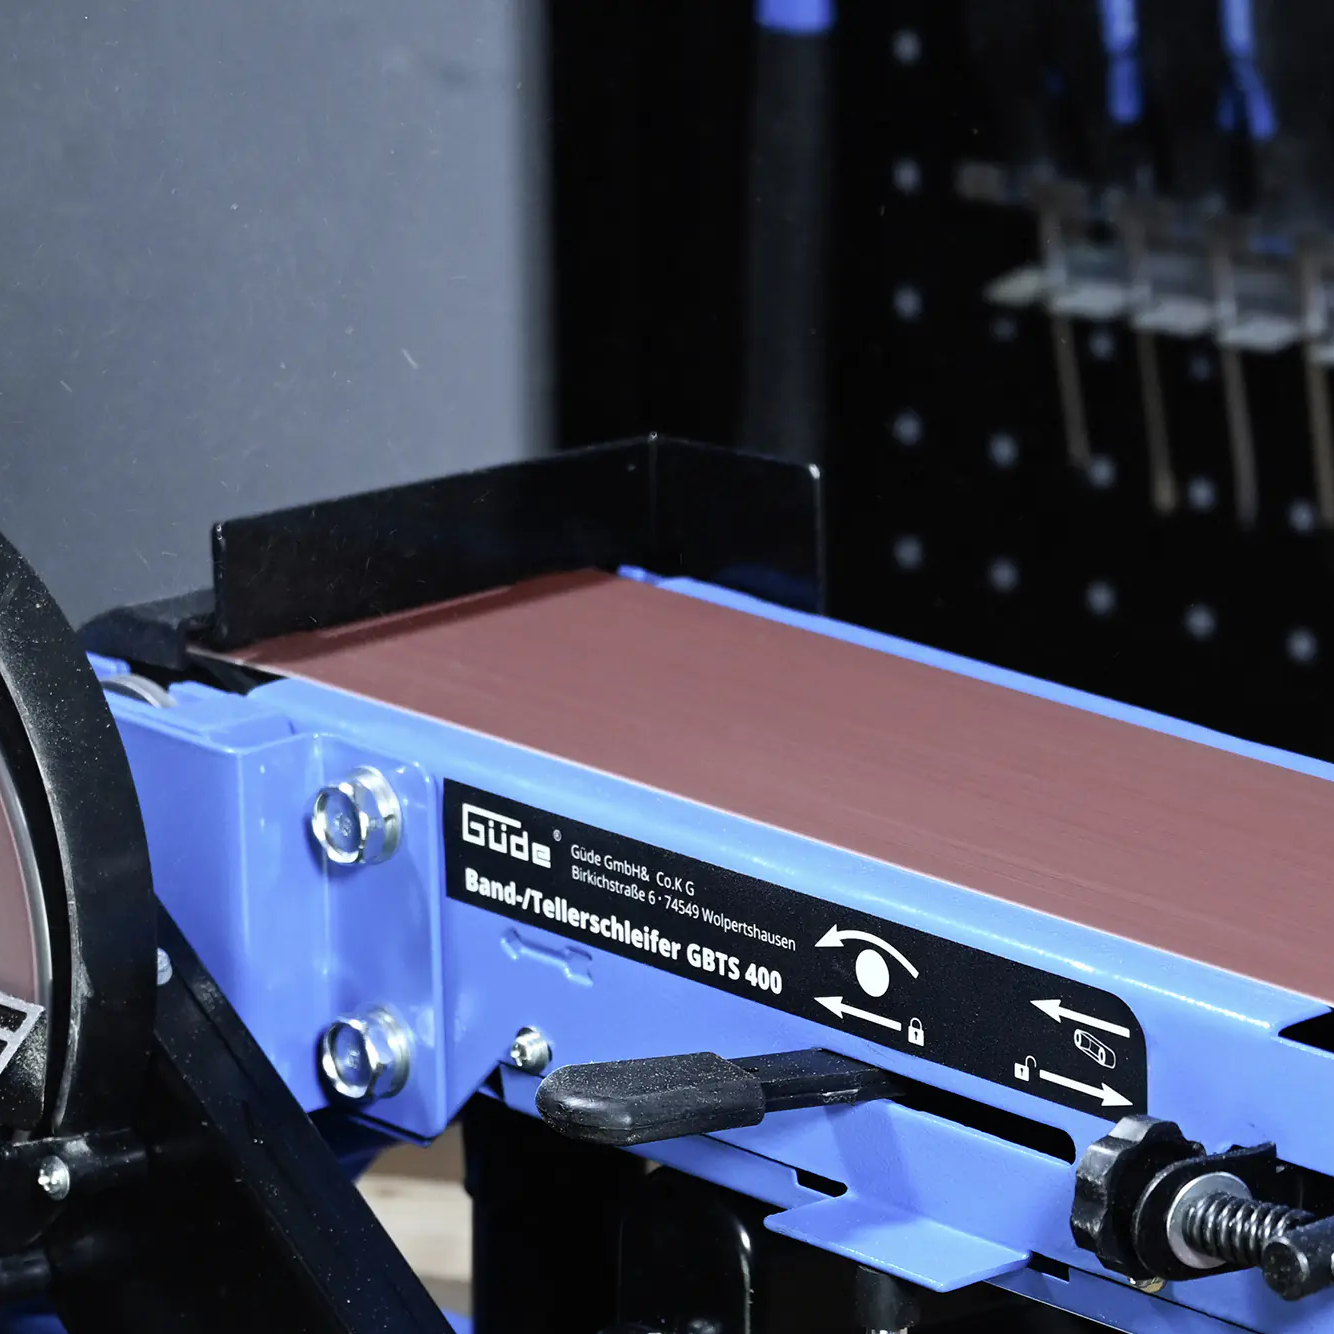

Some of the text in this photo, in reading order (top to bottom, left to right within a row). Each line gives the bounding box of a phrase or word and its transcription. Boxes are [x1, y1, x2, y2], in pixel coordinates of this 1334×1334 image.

[462, 802, 551, 868] Güde
[571, 844, 601, 866] Güde
[604, 855, 650, 882] GmbH&
[465, 867, 783, 995] Band-/Tellerschleifer GBTS 400
[571, 865, 796, 951] Birkichstraße 6 74549 Wolpertshausen
